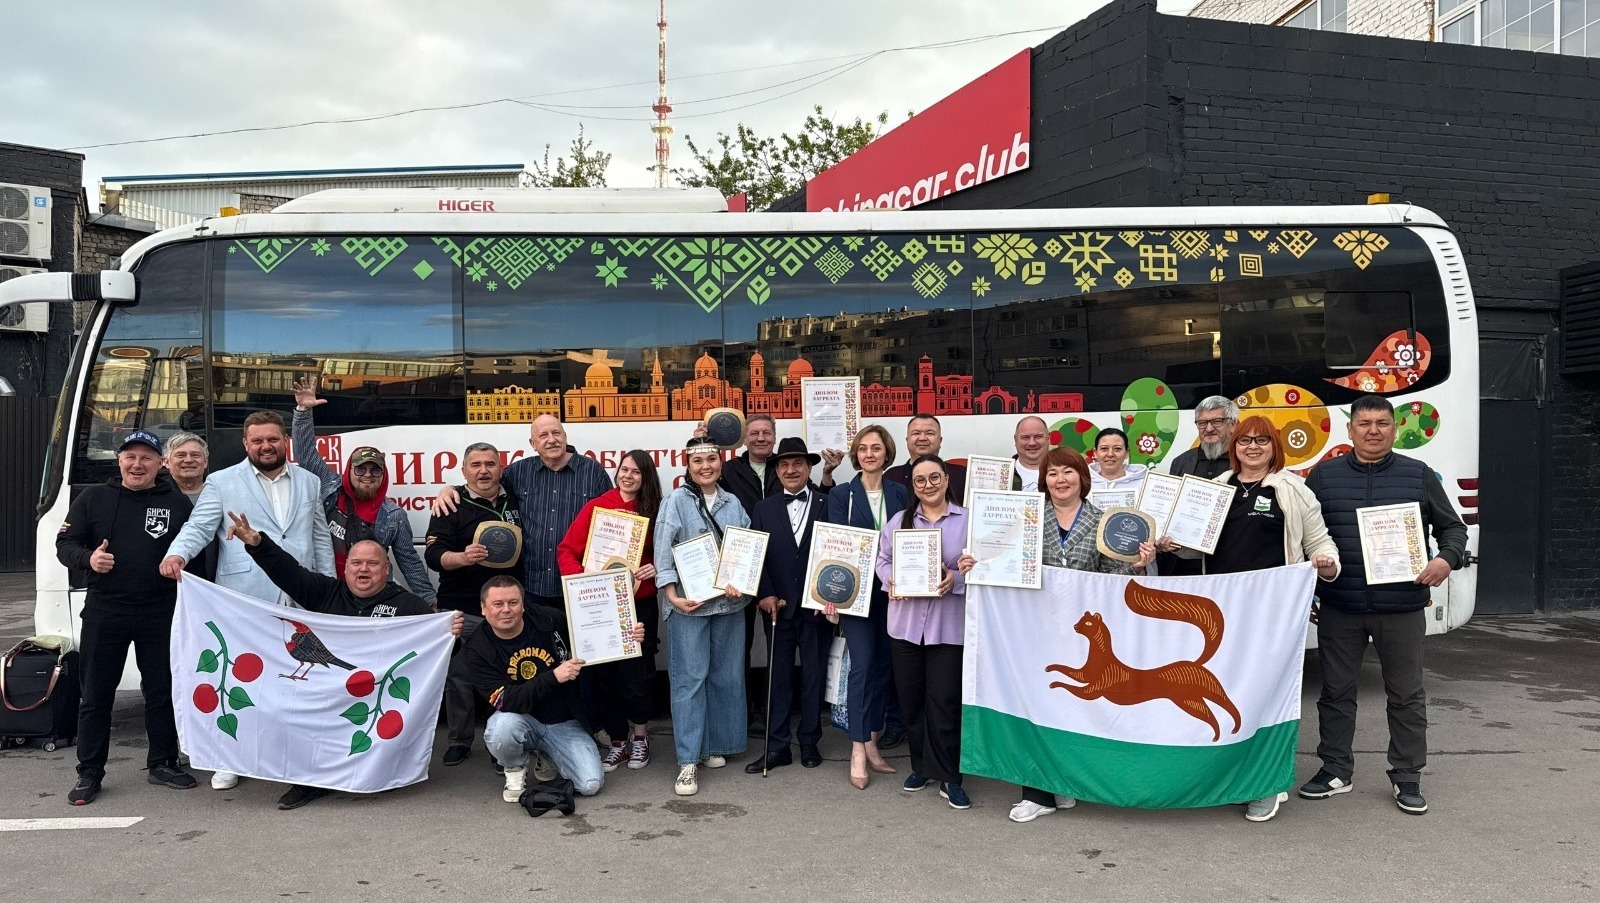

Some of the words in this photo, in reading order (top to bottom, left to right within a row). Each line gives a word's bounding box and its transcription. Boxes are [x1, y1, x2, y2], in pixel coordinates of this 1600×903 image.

[438, 199, 495, 211] HIGER
[146, 507, 170, 517] БИРСК
[984, 505, 1016, 513] ДИПЛОМ
[982, 512, 1017, 520] ЛАУРЕАТА
[579, 586, 607, 596] ДИПЛОМ
[577, 592, 610, 601] ЛАУРЕАТА
